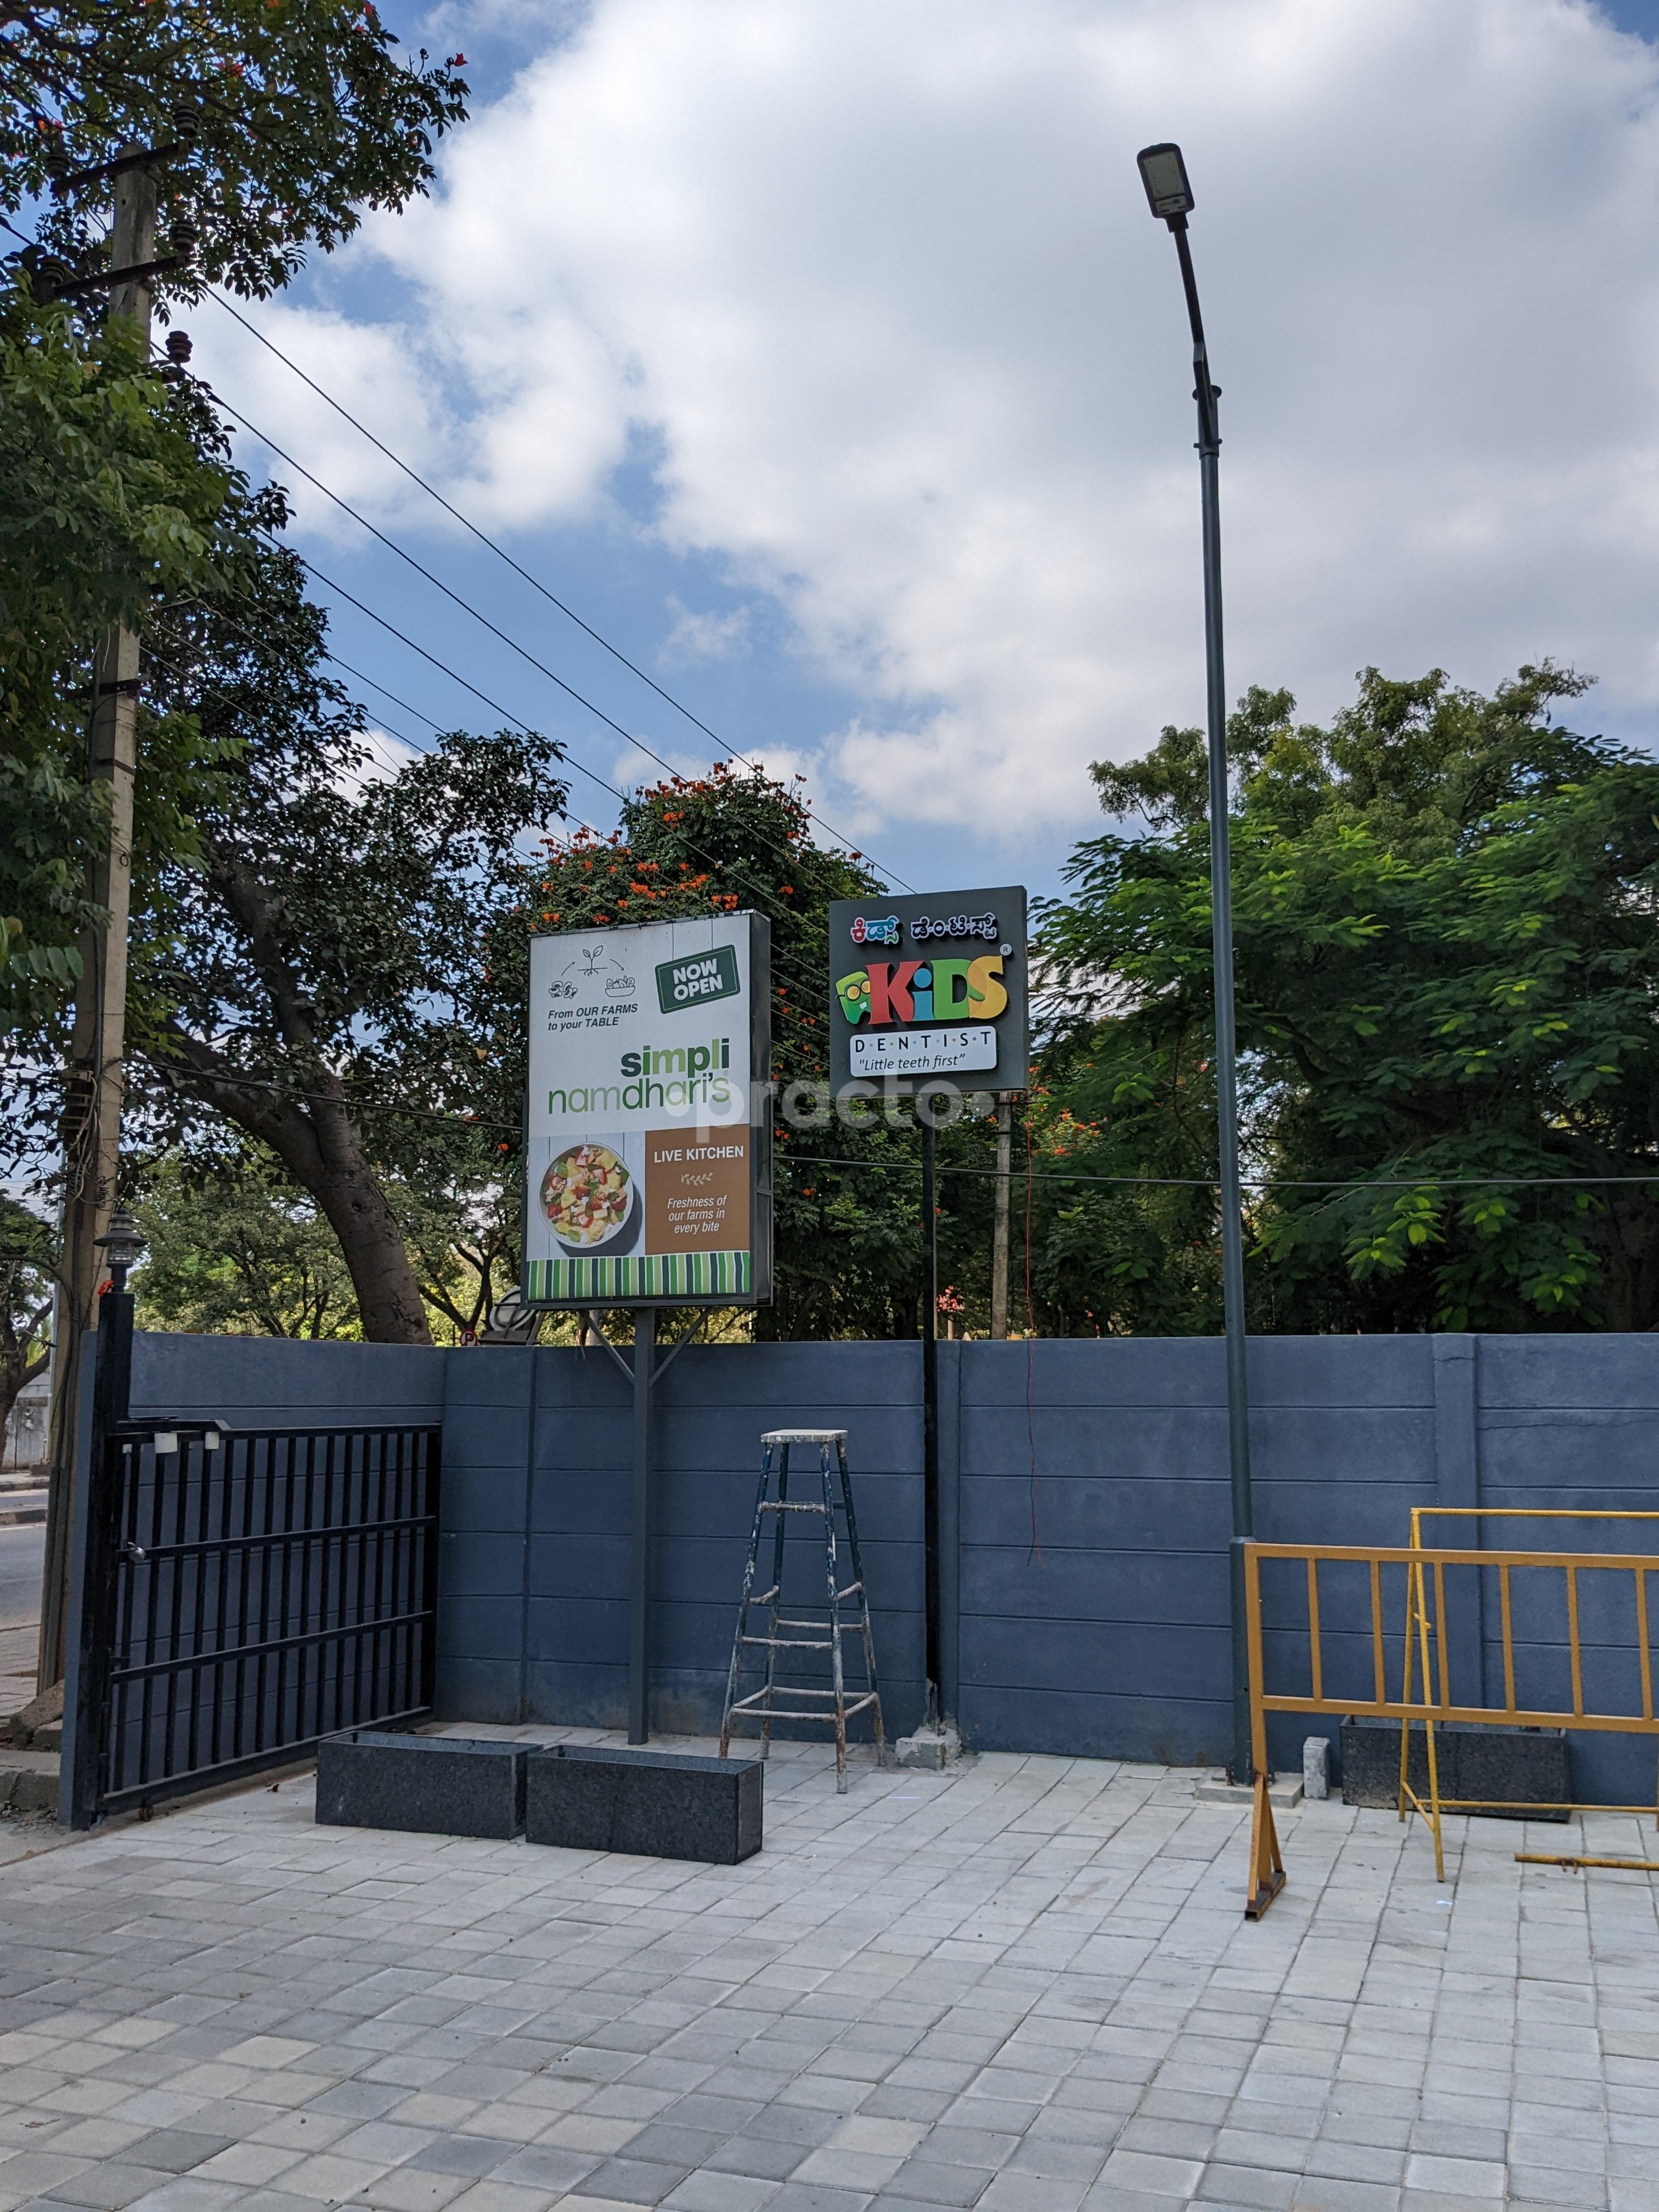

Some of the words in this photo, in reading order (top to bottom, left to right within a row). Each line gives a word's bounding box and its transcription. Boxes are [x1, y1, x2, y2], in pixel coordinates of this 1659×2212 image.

[673, 958, 717, 984] NOW
[674, 974, 723, 1001] OPEN
[548, 1010, 573, 1019] From
[576, 1007, 599, 1017] OUR
[601, 1003, 638, 1015] FARMS
[548, 1022, 558, 1030] to
[560, 1021, 583, 1032] your
[585, 1017, 619, 1028] TABLE
[620, 1038, 730, 1078] simpli
[898, 1056, 930, 1068] teeth
[654, 1149, 682, 1163] LIVE
[686, 1146, 744, 1160] KITCHEN
[667, 1197, 714, 1209] Freshness
[717, 1194, 727, 1206] of
[669, 1212, 685, 1221] our
[687, 1209, 714, 1220] farms
[716, 1207, 725, 1218] in
[674, 1224, 700, 1234] every
[702, 1221, 719, 1232] bite
